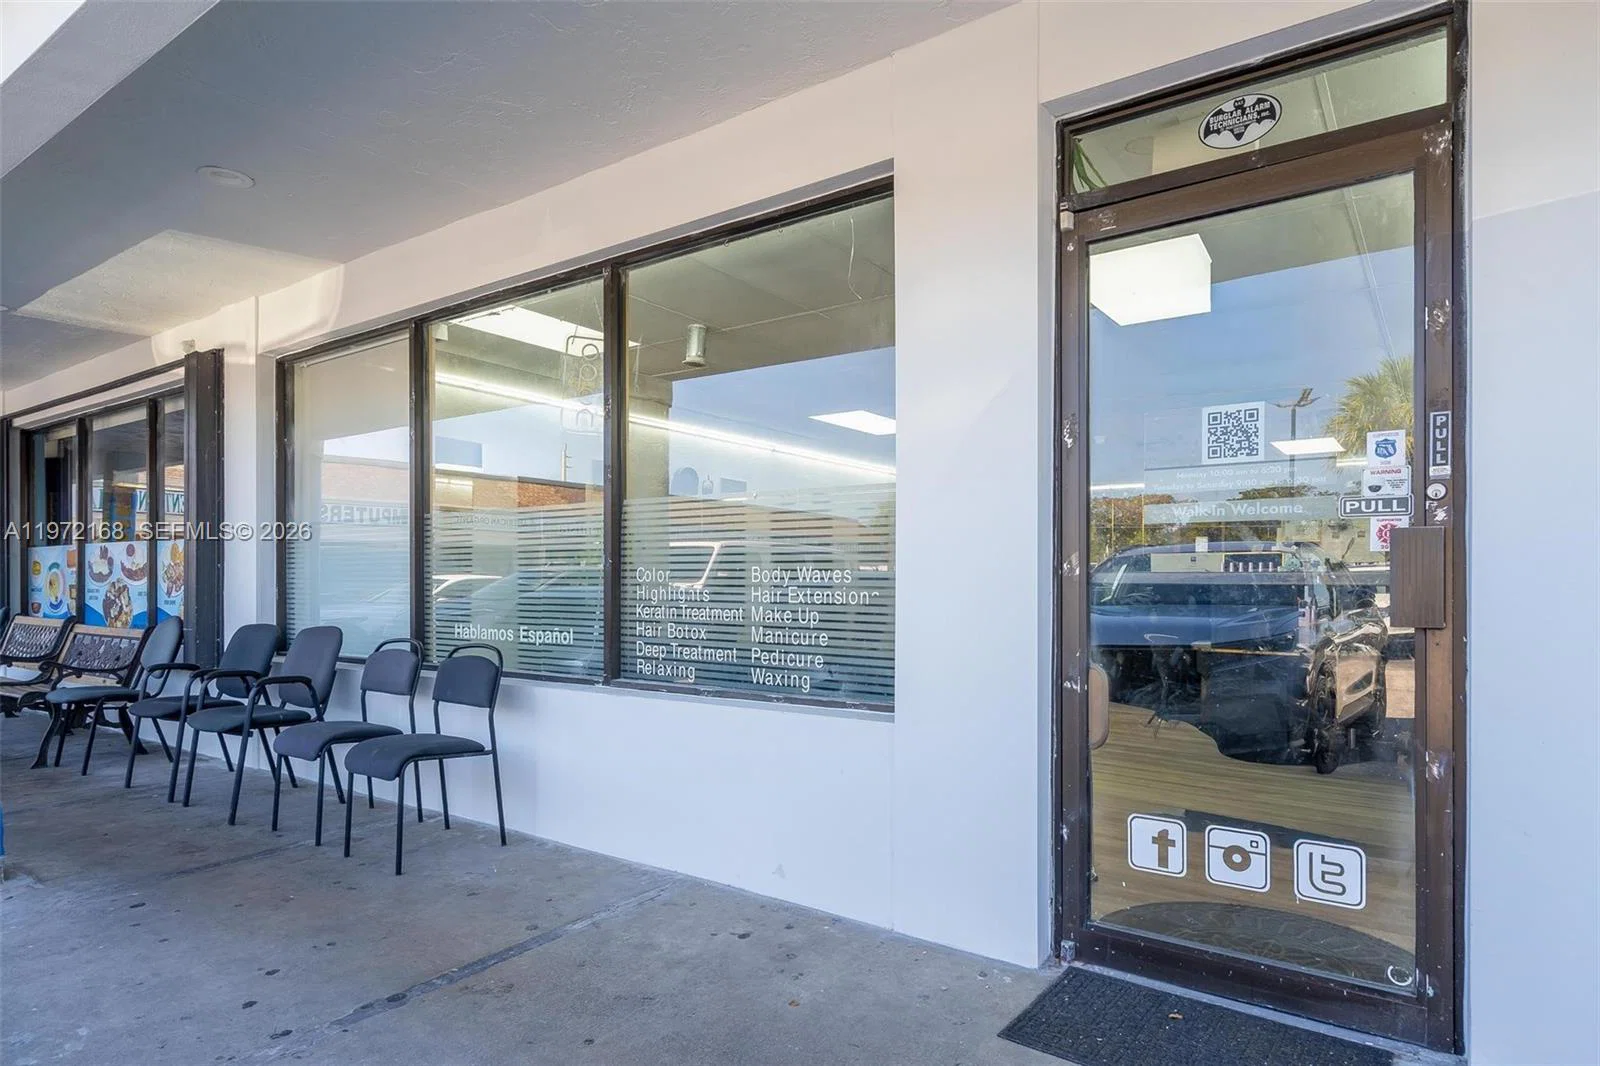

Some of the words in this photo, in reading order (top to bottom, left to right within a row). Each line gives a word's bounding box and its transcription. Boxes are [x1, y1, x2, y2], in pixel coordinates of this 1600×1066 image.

[1209, 110, 1242, 124] BURGLAR
[1245, 101, 1271, 114] ALARM
[1209, 113, 1260, 130] TECHNICIANS,
[1436, 416, 1448, 464] PULL
[1232, 502, 1304, 516] Welcome
[1345, 499, 1406, 512] PULL
[636, 567, 671, 582] Color
[751, 566, 791, 587] Body
[796, 566, 852, 584] Waves
[636, 585, 710, 604] Highlights
[751, 587, 781, 603] Hair
[636, 604, 677, 619] Keratin
[680, 605, 743, 622] Treatment
[751, 606, 792, 623] Make
[798, 608, 819, 628] Up
[454, 624, 514, 641] Hablamos
[520, 625, 574, 646] Español
[636, 623, 662, 638] Hair
[667, 625, 707, 640] Botox
[751, 627, 829, 646] Manicure
[636, 641, 667, 659] Deep
[670, 643, 737, 663] Treatment
[751, 648, 824, 669] Pedicure
[636, 659, 696, 683] Relaxing
[751, 668, 810, 693] Waxing
